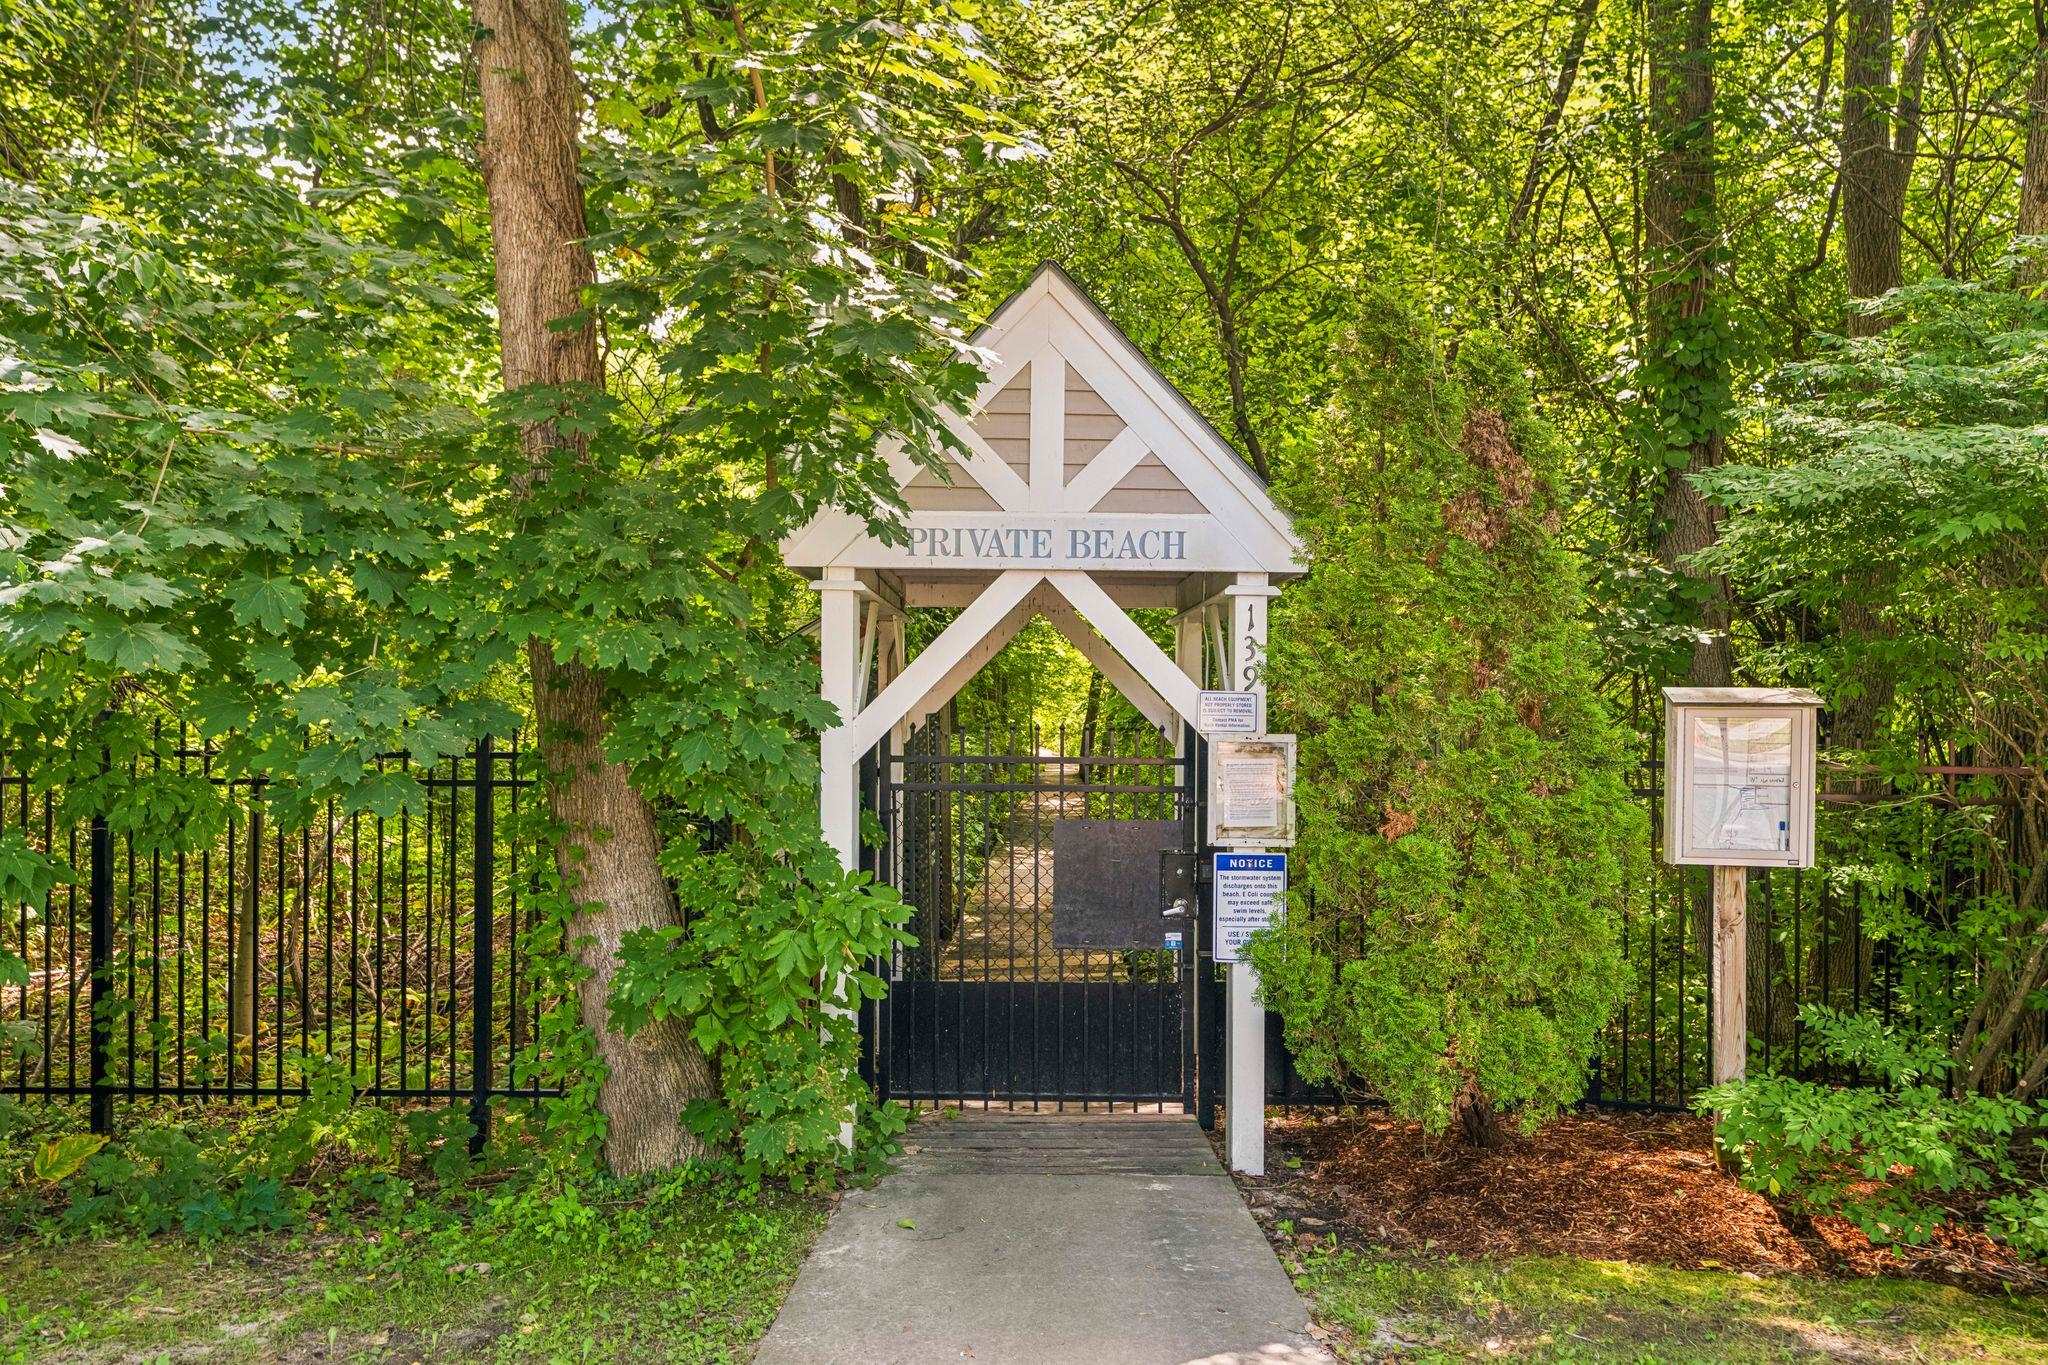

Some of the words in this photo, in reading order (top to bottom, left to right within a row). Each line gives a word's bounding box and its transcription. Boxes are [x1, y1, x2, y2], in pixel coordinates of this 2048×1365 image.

[905, 527, 1052, 559] PRIVATE
[1065, 529, 1187, 560] BEACH
[1229, 859, 1273, 868] NOTICE
